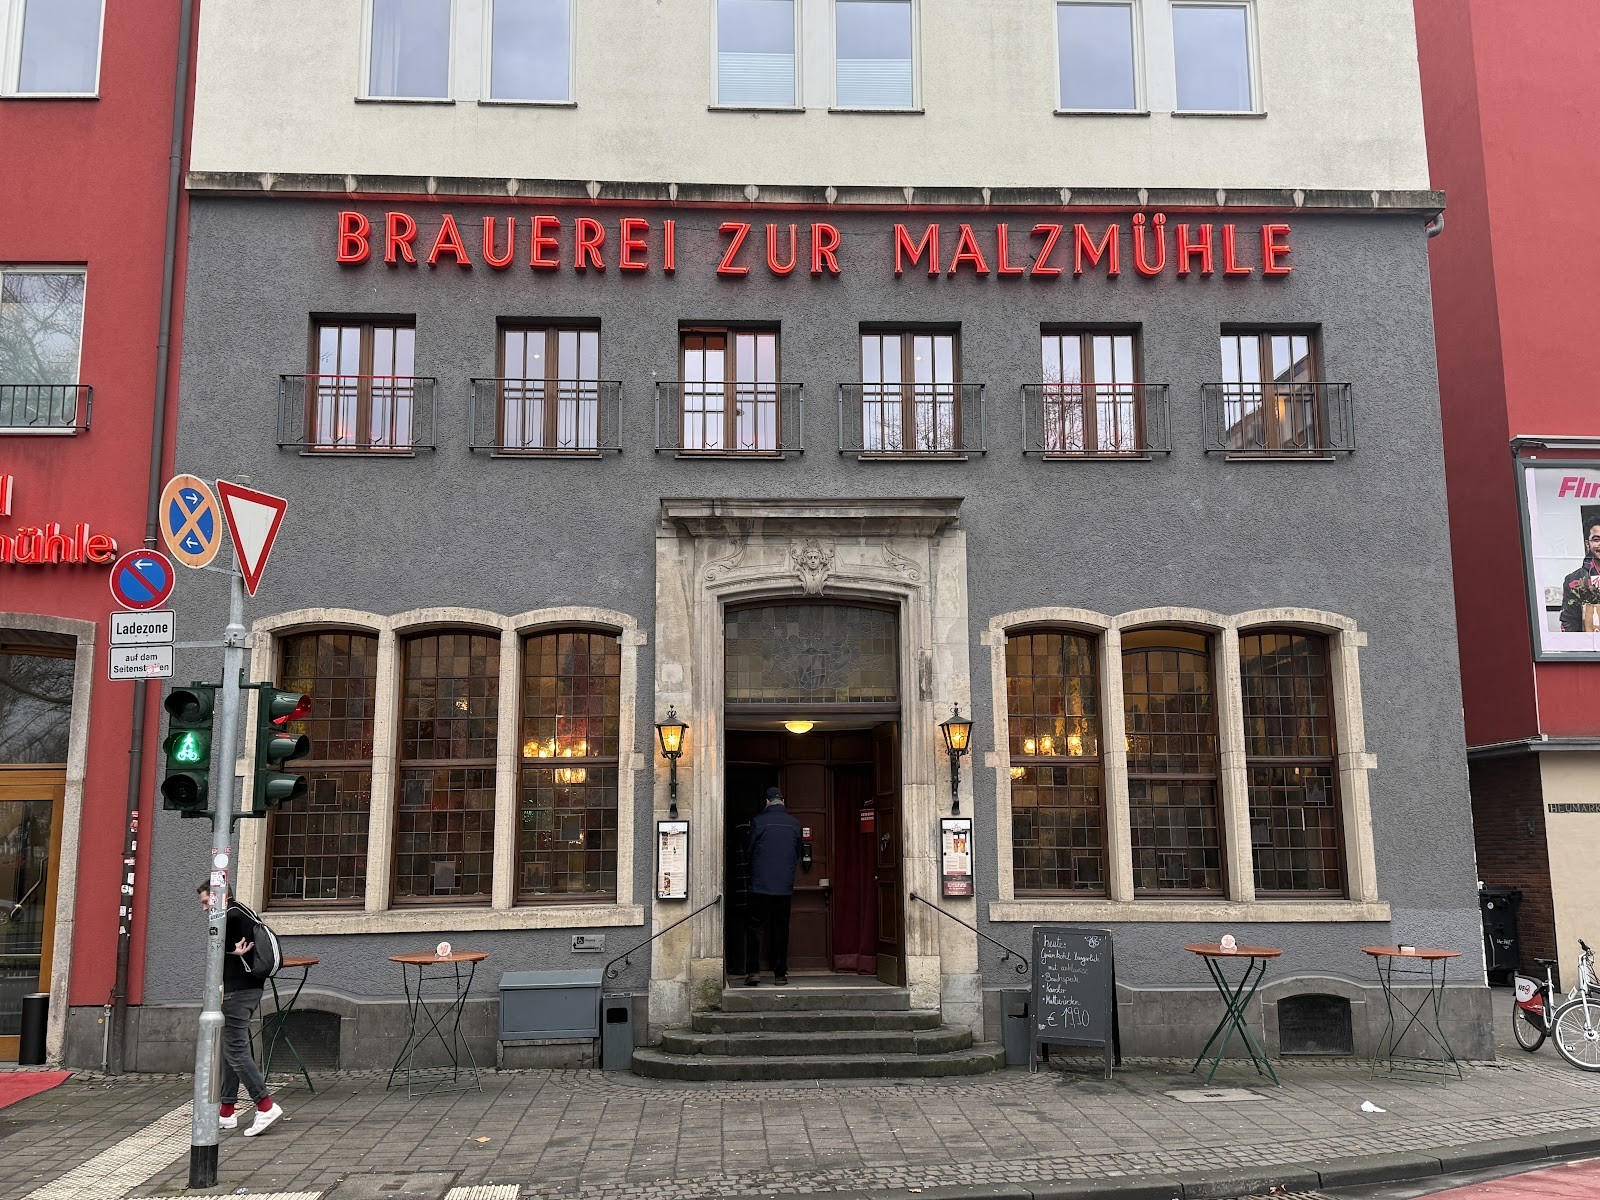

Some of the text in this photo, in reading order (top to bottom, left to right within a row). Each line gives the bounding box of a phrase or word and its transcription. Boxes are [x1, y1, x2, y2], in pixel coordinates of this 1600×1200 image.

[336, 211, 1294, 279] BRAUEREI ZUR MALZMÜHLE
[116, 621, 168, 635] Ladezone
[125, 653, 138, 662] auf
[113, 664, 169, 673] Seitensten
